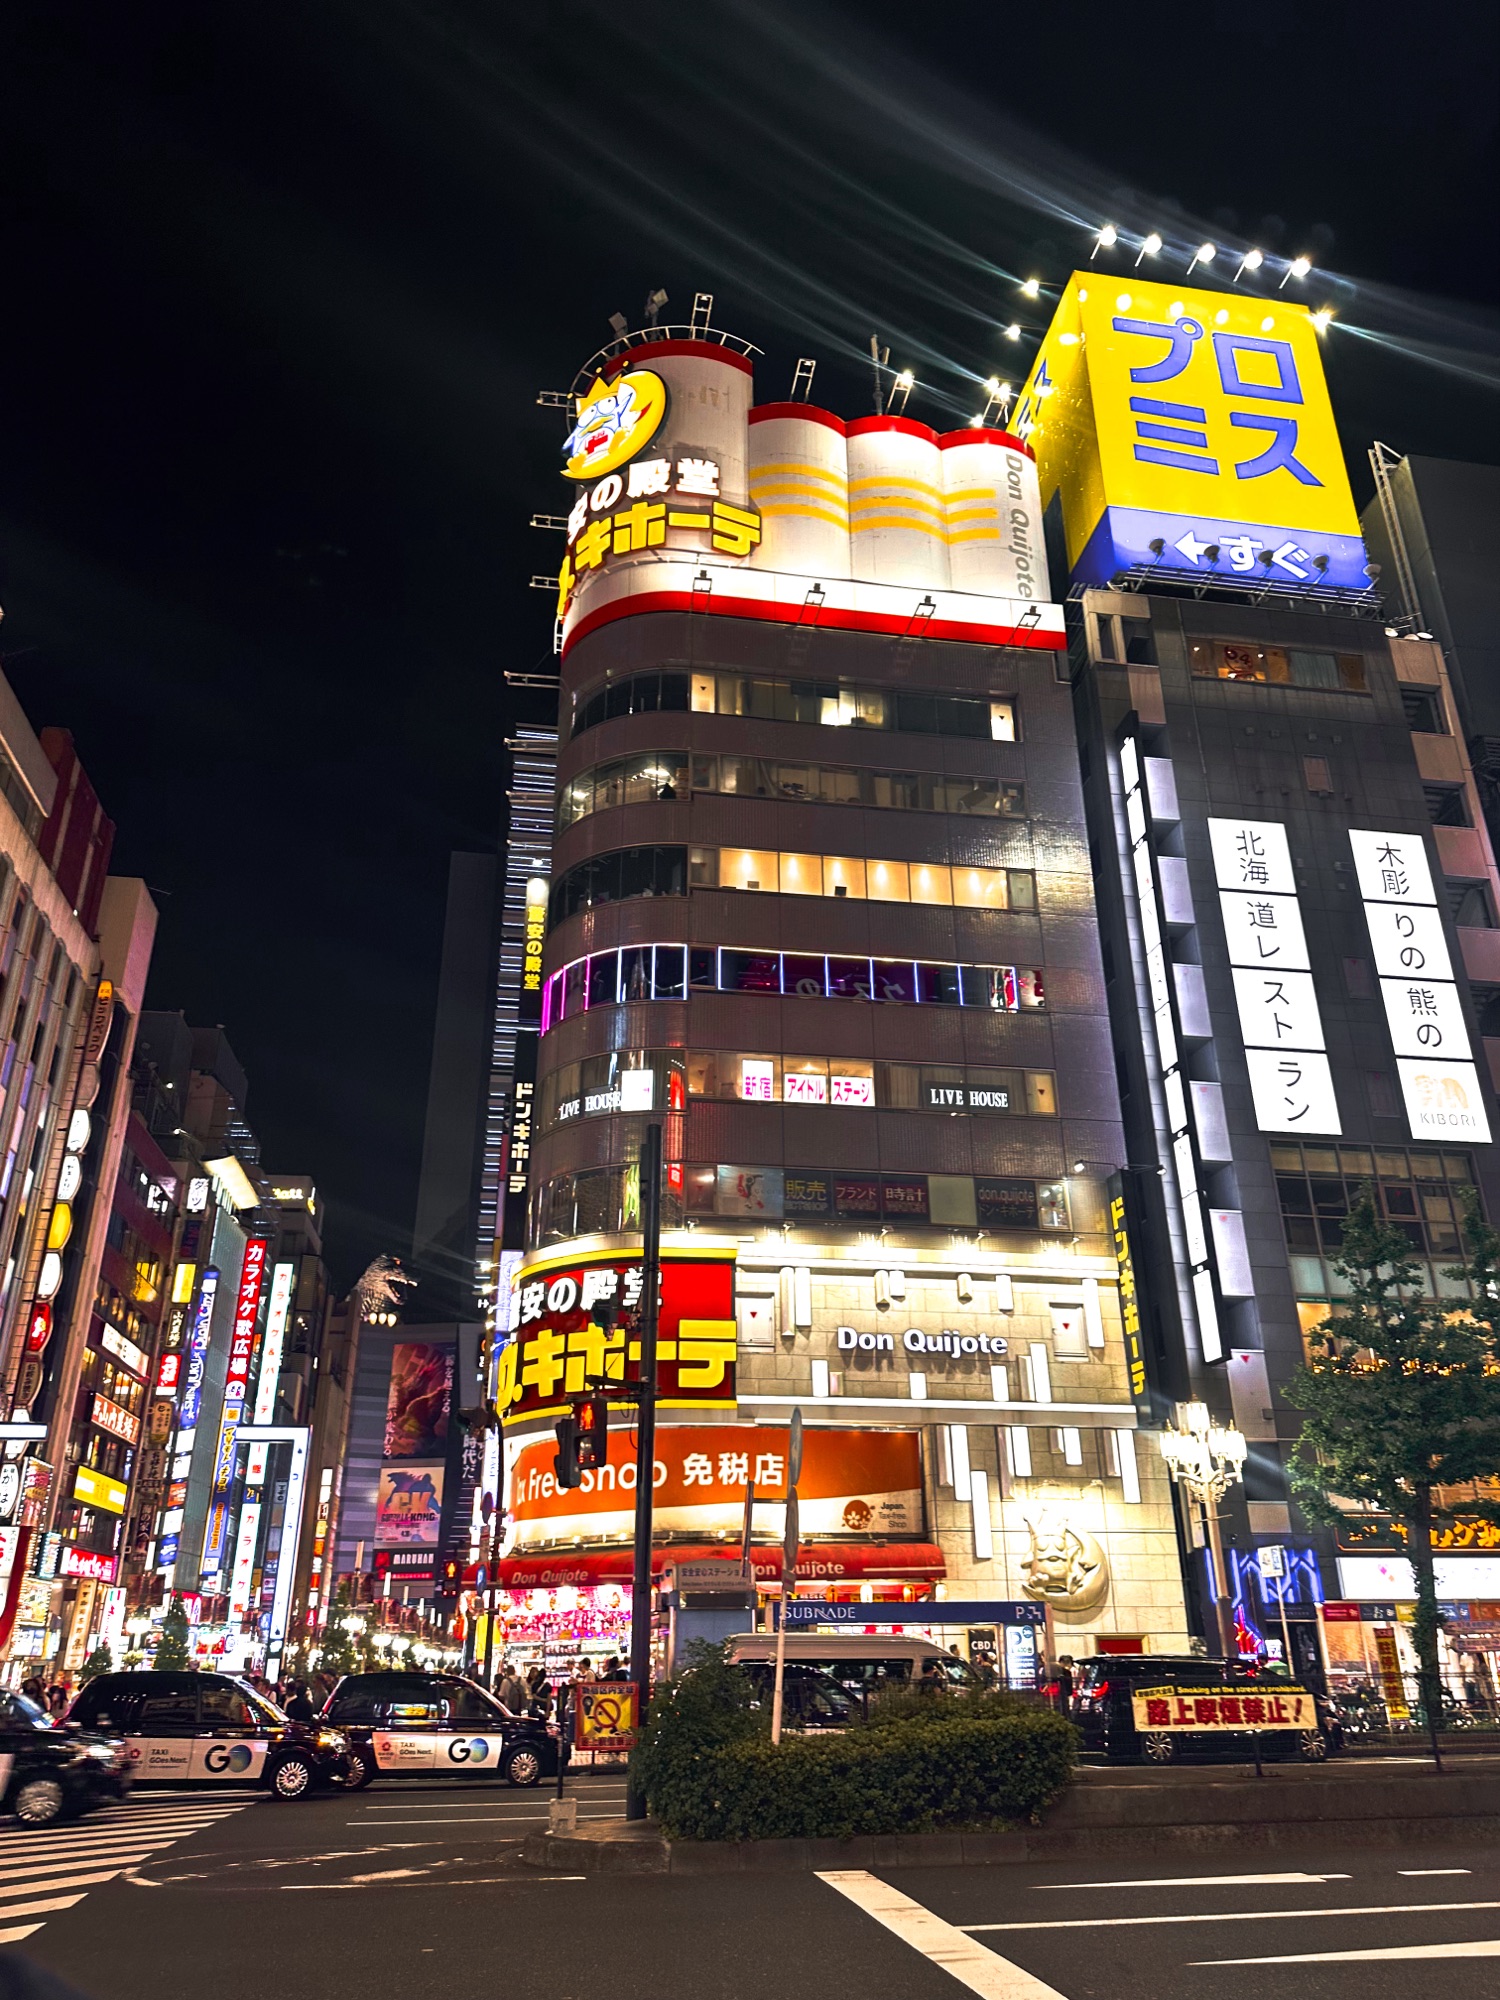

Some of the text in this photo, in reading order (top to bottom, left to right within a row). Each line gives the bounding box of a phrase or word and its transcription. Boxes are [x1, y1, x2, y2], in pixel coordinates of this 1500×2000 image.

[1112, 317, 1304, 404] プロ
[1129, 397, 1325, 487] ミス
[1004, 453, 1034, 599] Don Quijote
[1218, 535, 1312, 579] すぐ
[1375, 841, 1443, 1048] 木彫りの熊の
[1234, 830, 1311, 1122] 北海道レストラン
[745, 1076, 870, 1103] 新宿 アイドル ステージ
[931, 1088, 1008, 1108] LIVE HOUSE
[559, 1091, 622, 1120] LIVE HOUSE
[1418, 1111, 1476, 1127] KIBORI
[786, 1179, 827, 1201] 販売
[835, 1186, 877, 1200] ブランド
[885, 1188, 926, 1202] 時計
[229, 1244, 264, 1376] カラオケ歌広場
[837, 1327, 1008, 1359] Don Quijote
[682, 1451, 785, 1487] 免税店
[878, 1511, 907, 1520] Tax-free
[880, 1501, 906, 1511] Japan.
[888, 1519, 907, 1529] Shop
[511, 1569, 589, 1585] Don Quijote
[681, 1567, 746, 1577] 安全安心ステーショ
[785, 1605, 1025, 1621] SUBNADE P
[971, 1640, 991, 1650] CBD
[1177, 1686, 1210, 1695] Smoking
[1222, 1686, 1234, 1694] the
[1236, 1686, 1258, 1694] street
[151, 1748, 169, 1756] TAXI
[204, 1744, 253, 1773] GO
[448, 1737, 490, 1763] GO
